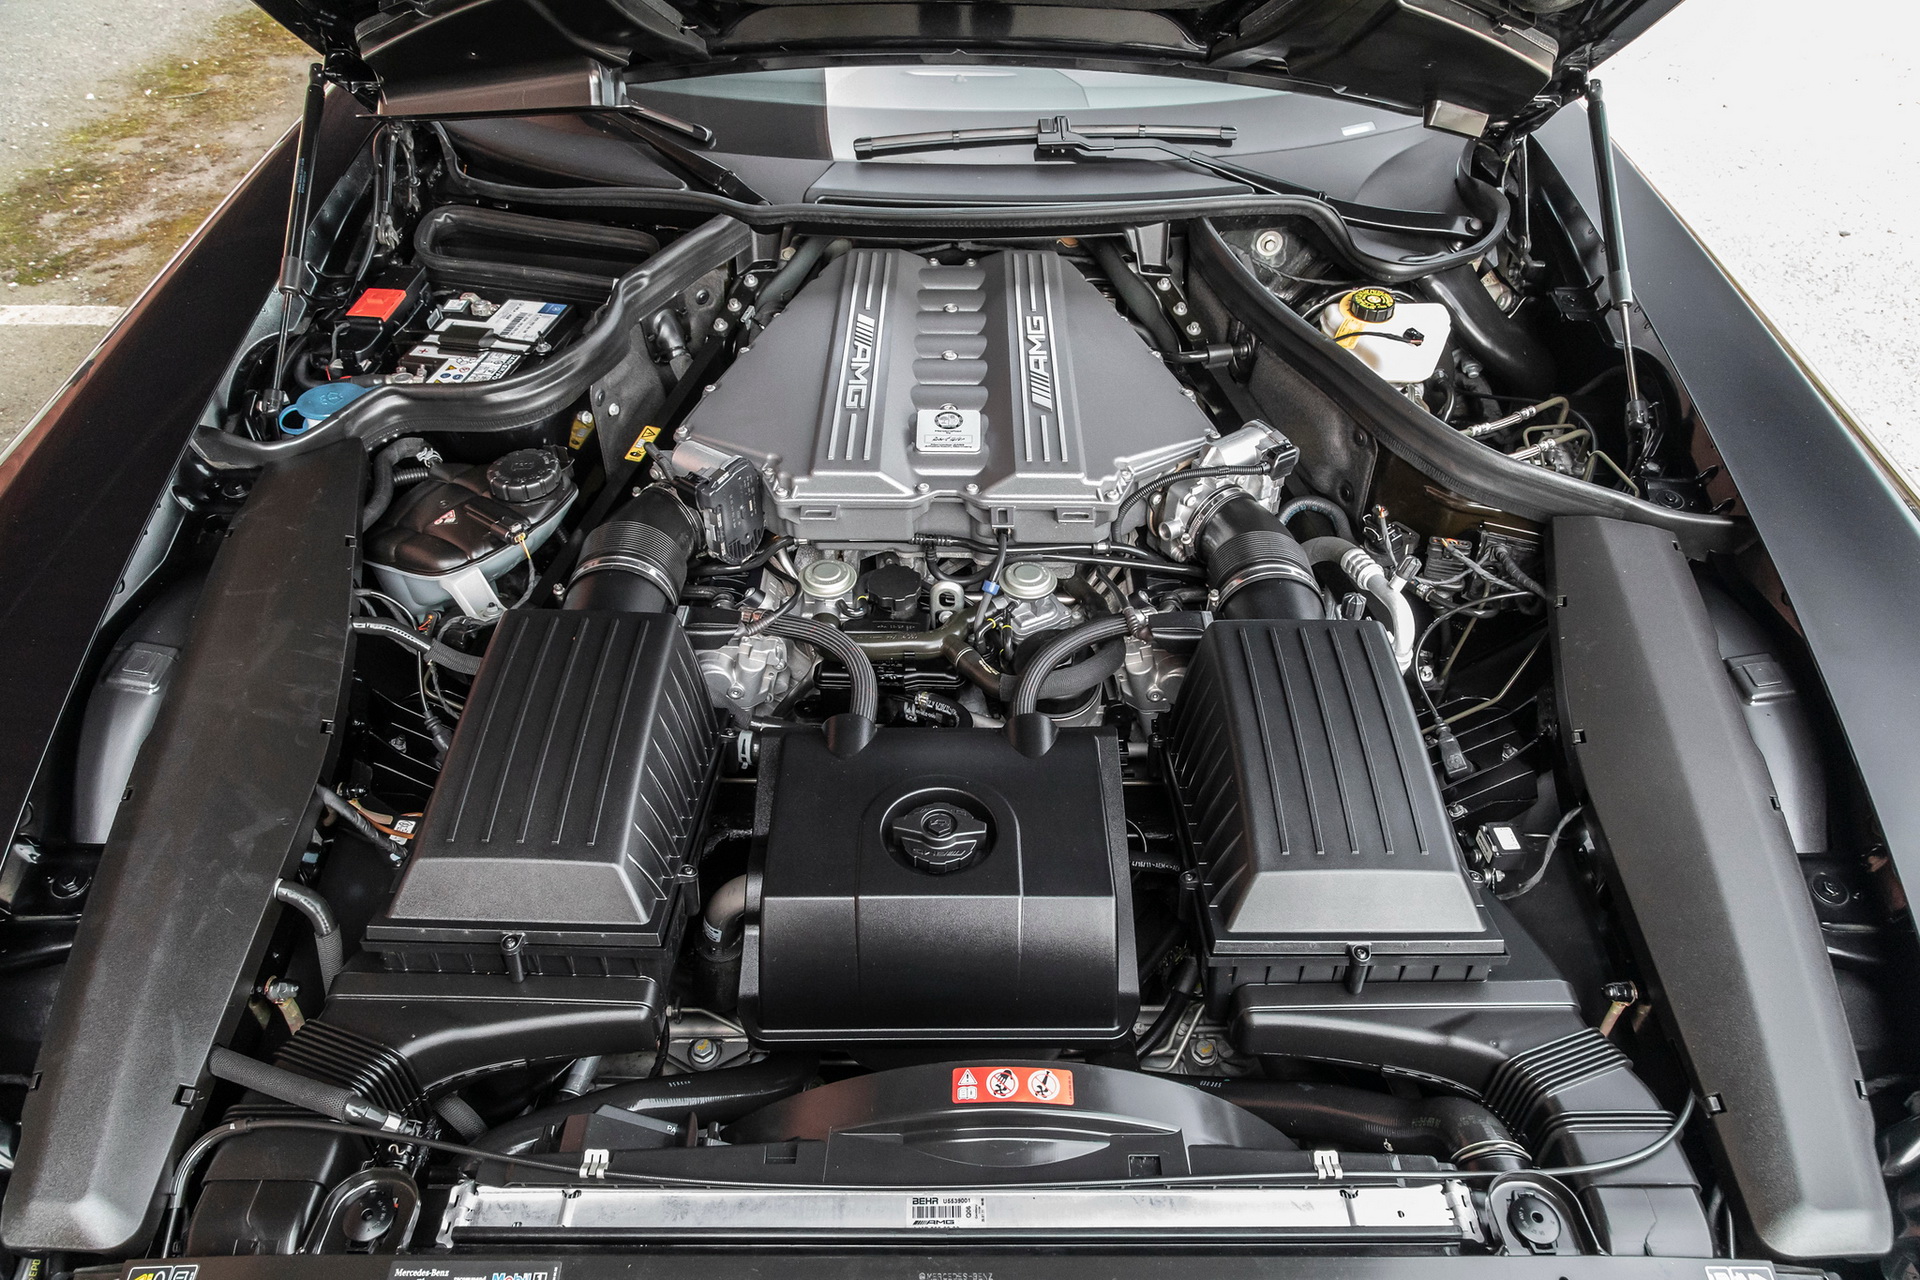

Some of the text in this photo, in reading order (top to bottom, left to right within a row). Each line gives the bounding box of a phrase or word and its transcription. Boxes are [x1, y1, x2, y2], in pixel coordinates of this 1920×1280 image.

[845, 339, 872, 408] AMG
[1026, 316, 1049, 379] AMG
[394, 1268, 450, 1277] Mercedes-Benz
